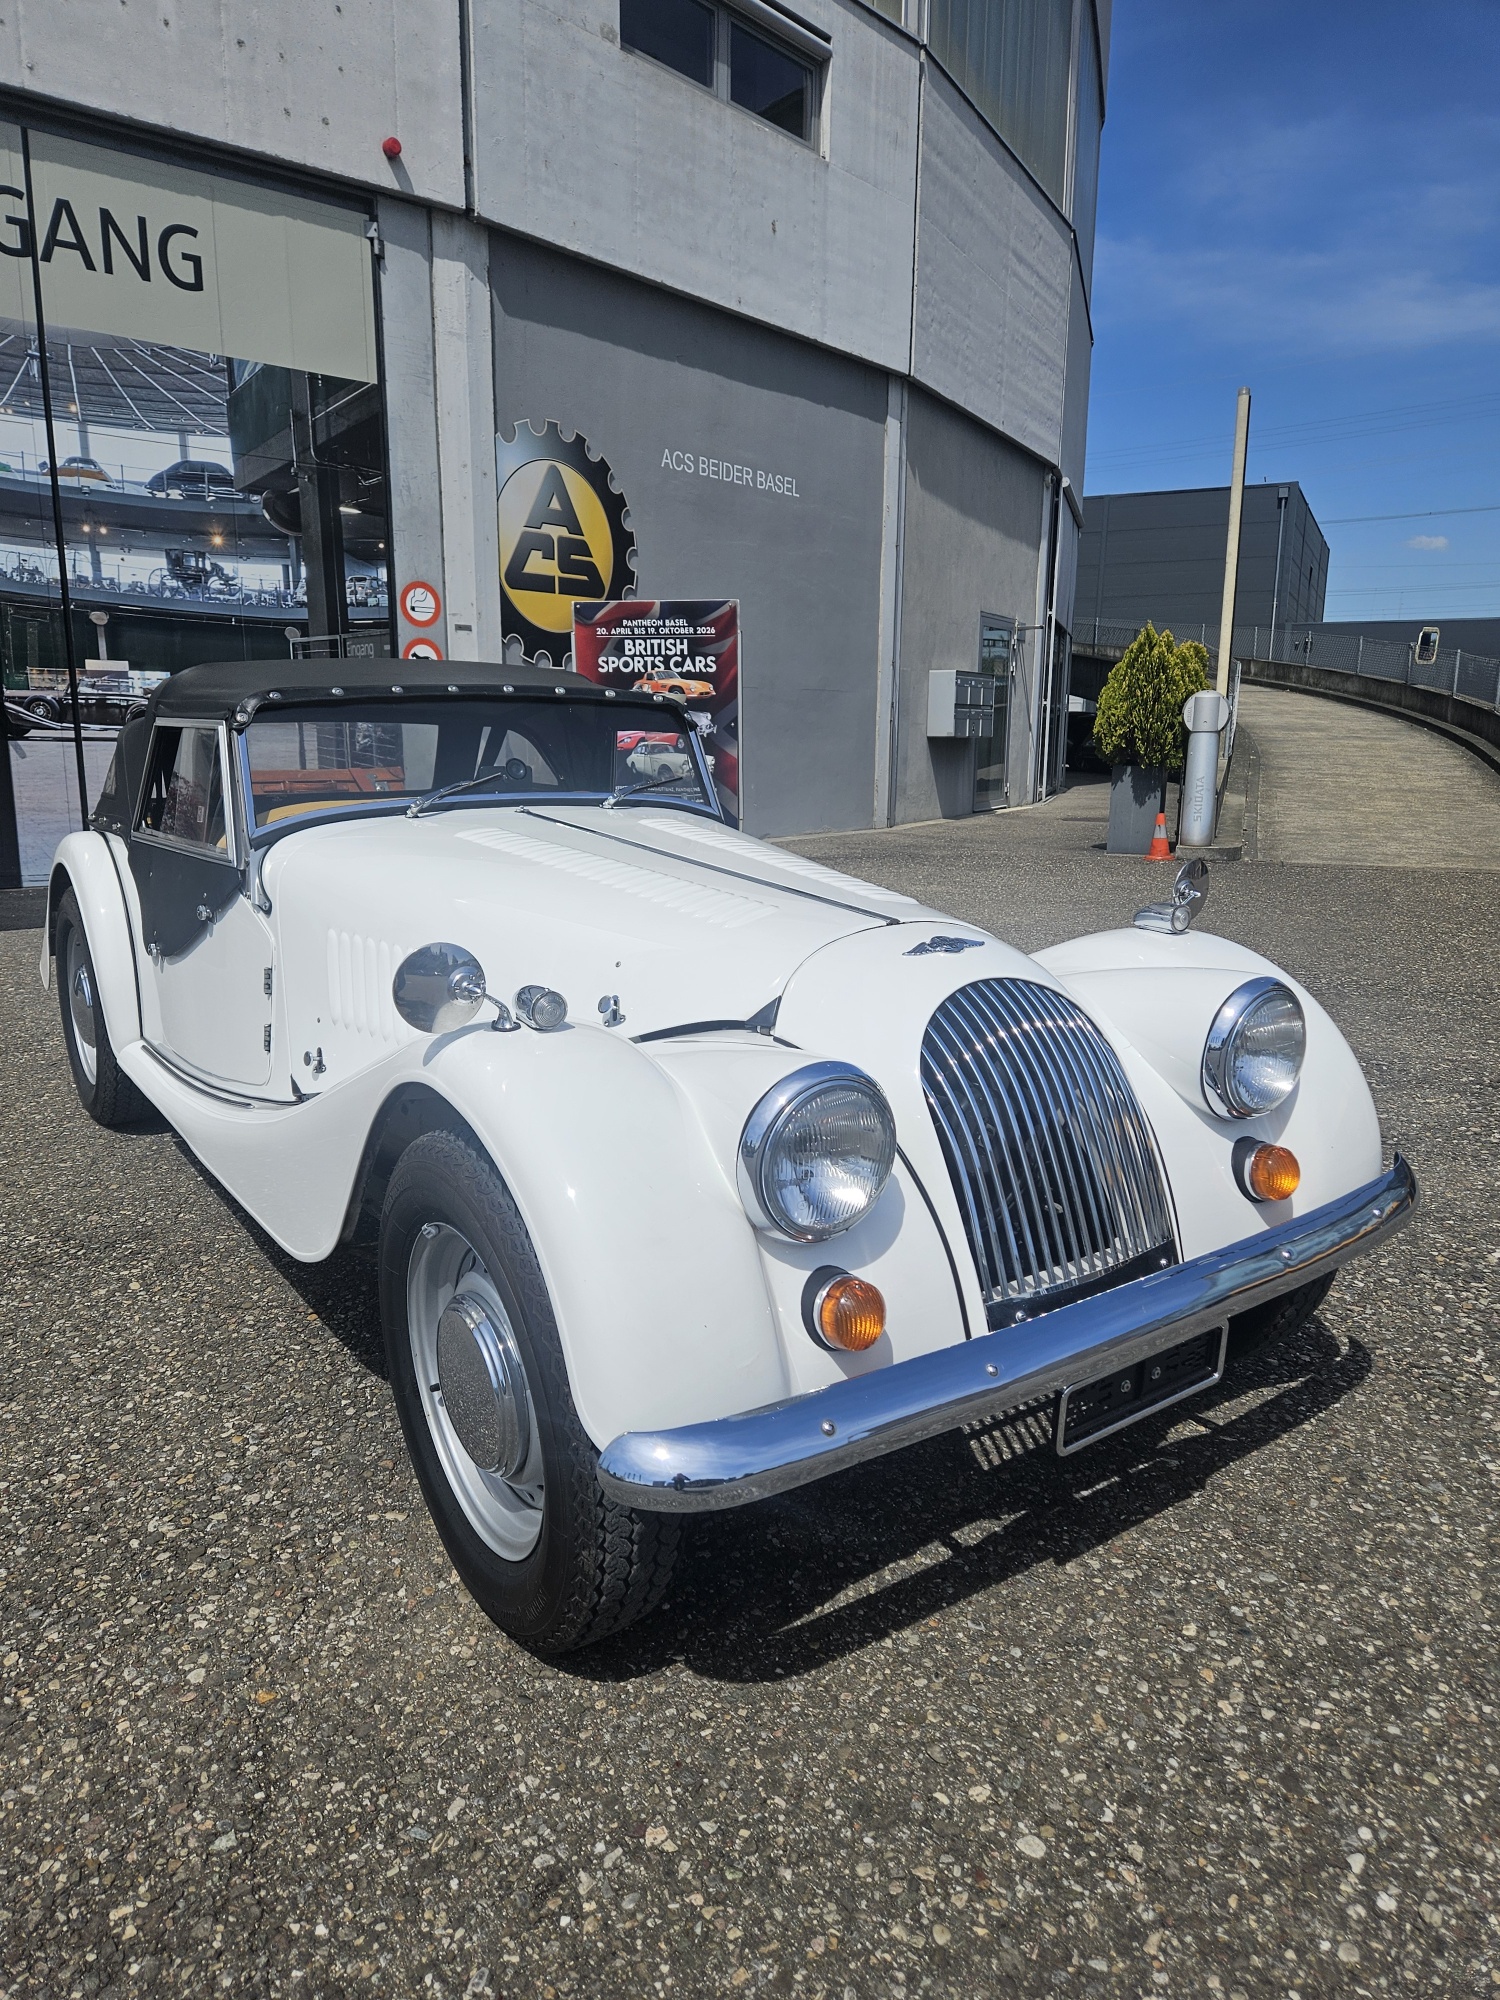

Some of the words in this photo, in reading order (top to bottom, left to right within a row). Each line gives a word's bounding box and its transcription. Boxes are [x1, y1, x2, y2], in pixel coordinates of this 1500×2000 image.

[661, 448, 695, 474] ACS
[699, 456, 753, 487] BEIDER
[757, 470, 800, 498] BASEL
[596, 627, 609, 635] 20.
[611, 627, 632, 635] APRIL
[634, 627, 646, 635] BIS
[647, 627, 657, 635] 19.
[659, 626, 694, 635] OKTOBER
[696, 626, 716, 634] 2026
[622, 619, 663, 627] PANTHEON
[665, 618, 688, 627] BASEL
[346, 641, 375, 658] Eingang
[624, 638, 688, 656] BRITISH
[597, 656, 665, 673] SPORTS
[669, 655, 717, 673] CARS
[1193, 775, 1205, 823] SKIDATA
